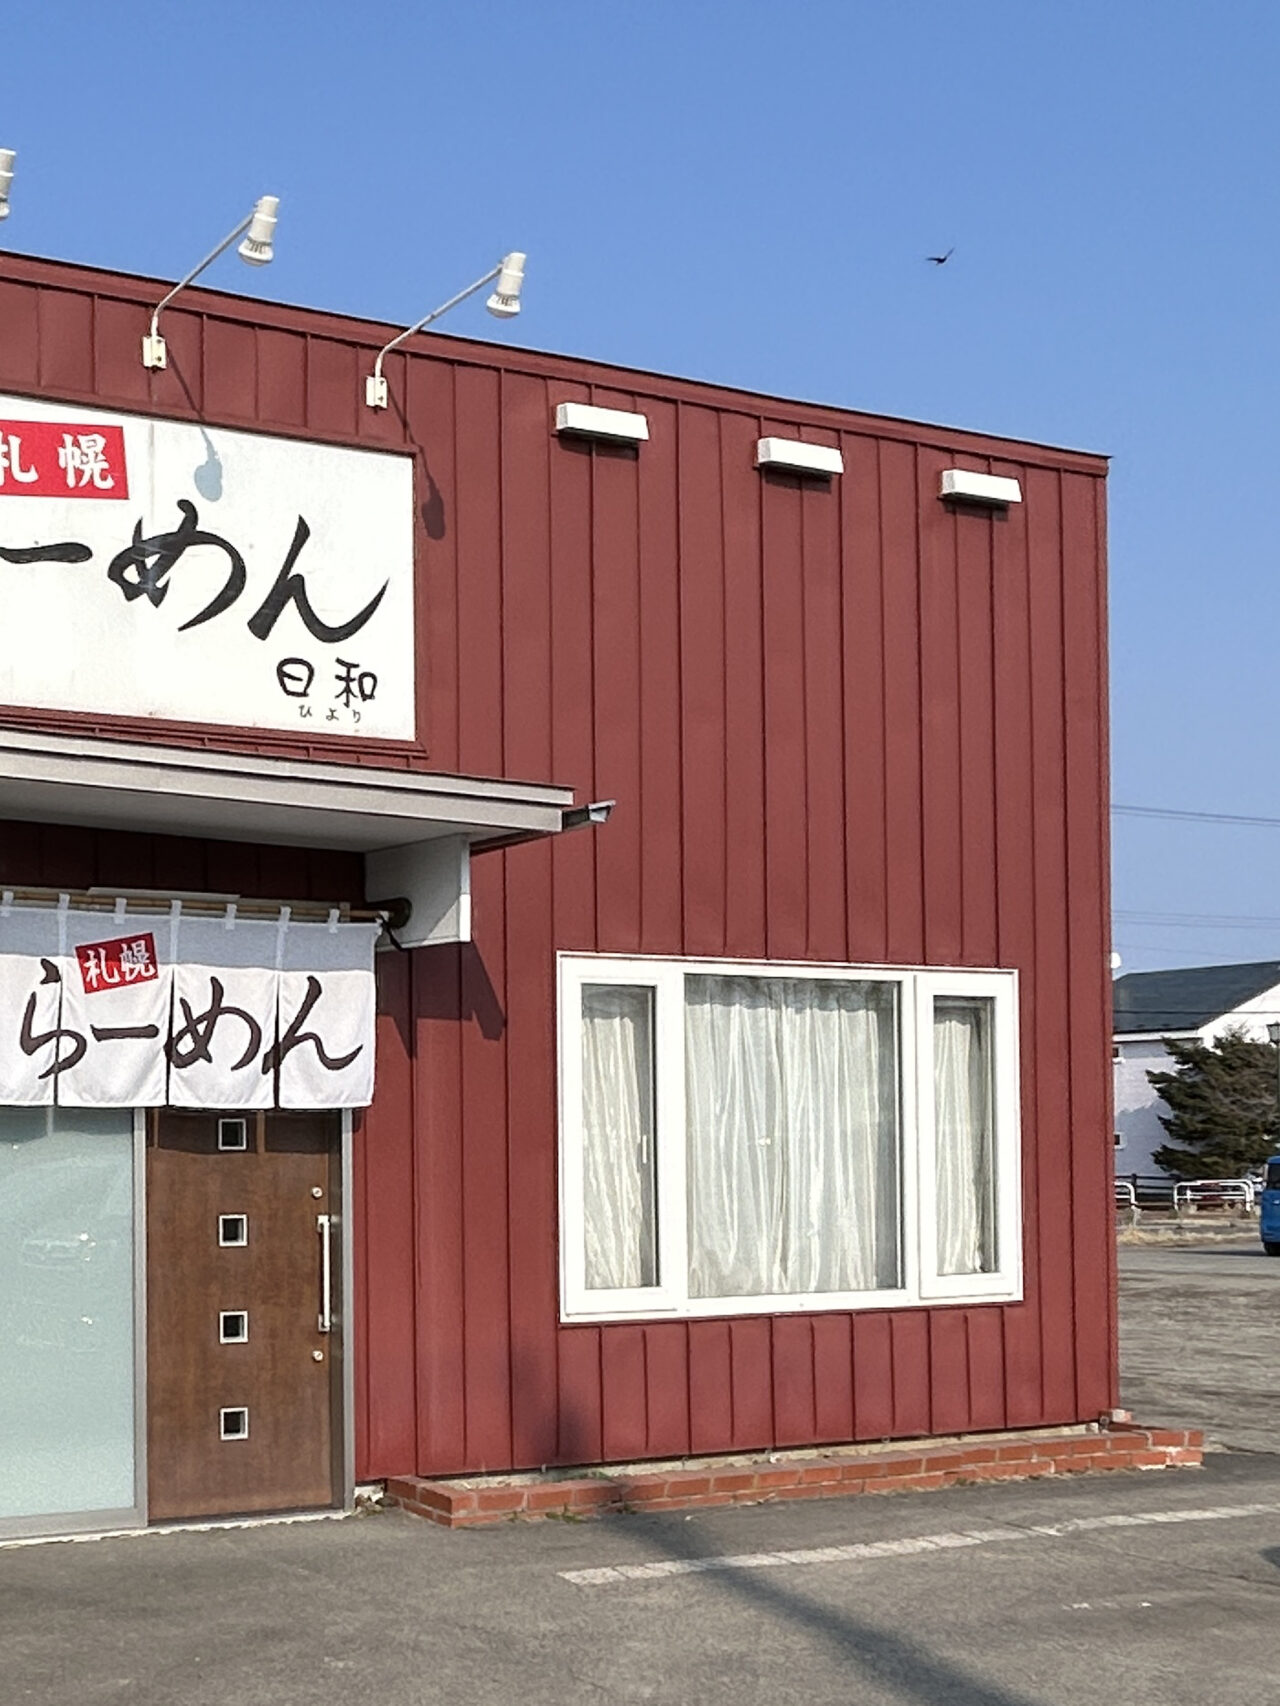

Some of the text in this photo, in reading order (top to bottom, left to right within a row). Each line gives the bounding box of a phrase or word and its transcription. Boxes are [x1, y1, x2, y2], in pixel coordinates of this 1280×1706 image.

[276, 657, 378, 708] 日和
[298, 704, 362, 723] ひより
[83, 939, 157, 989] 札幌
[20, 958, 363, 1080] らーめん
